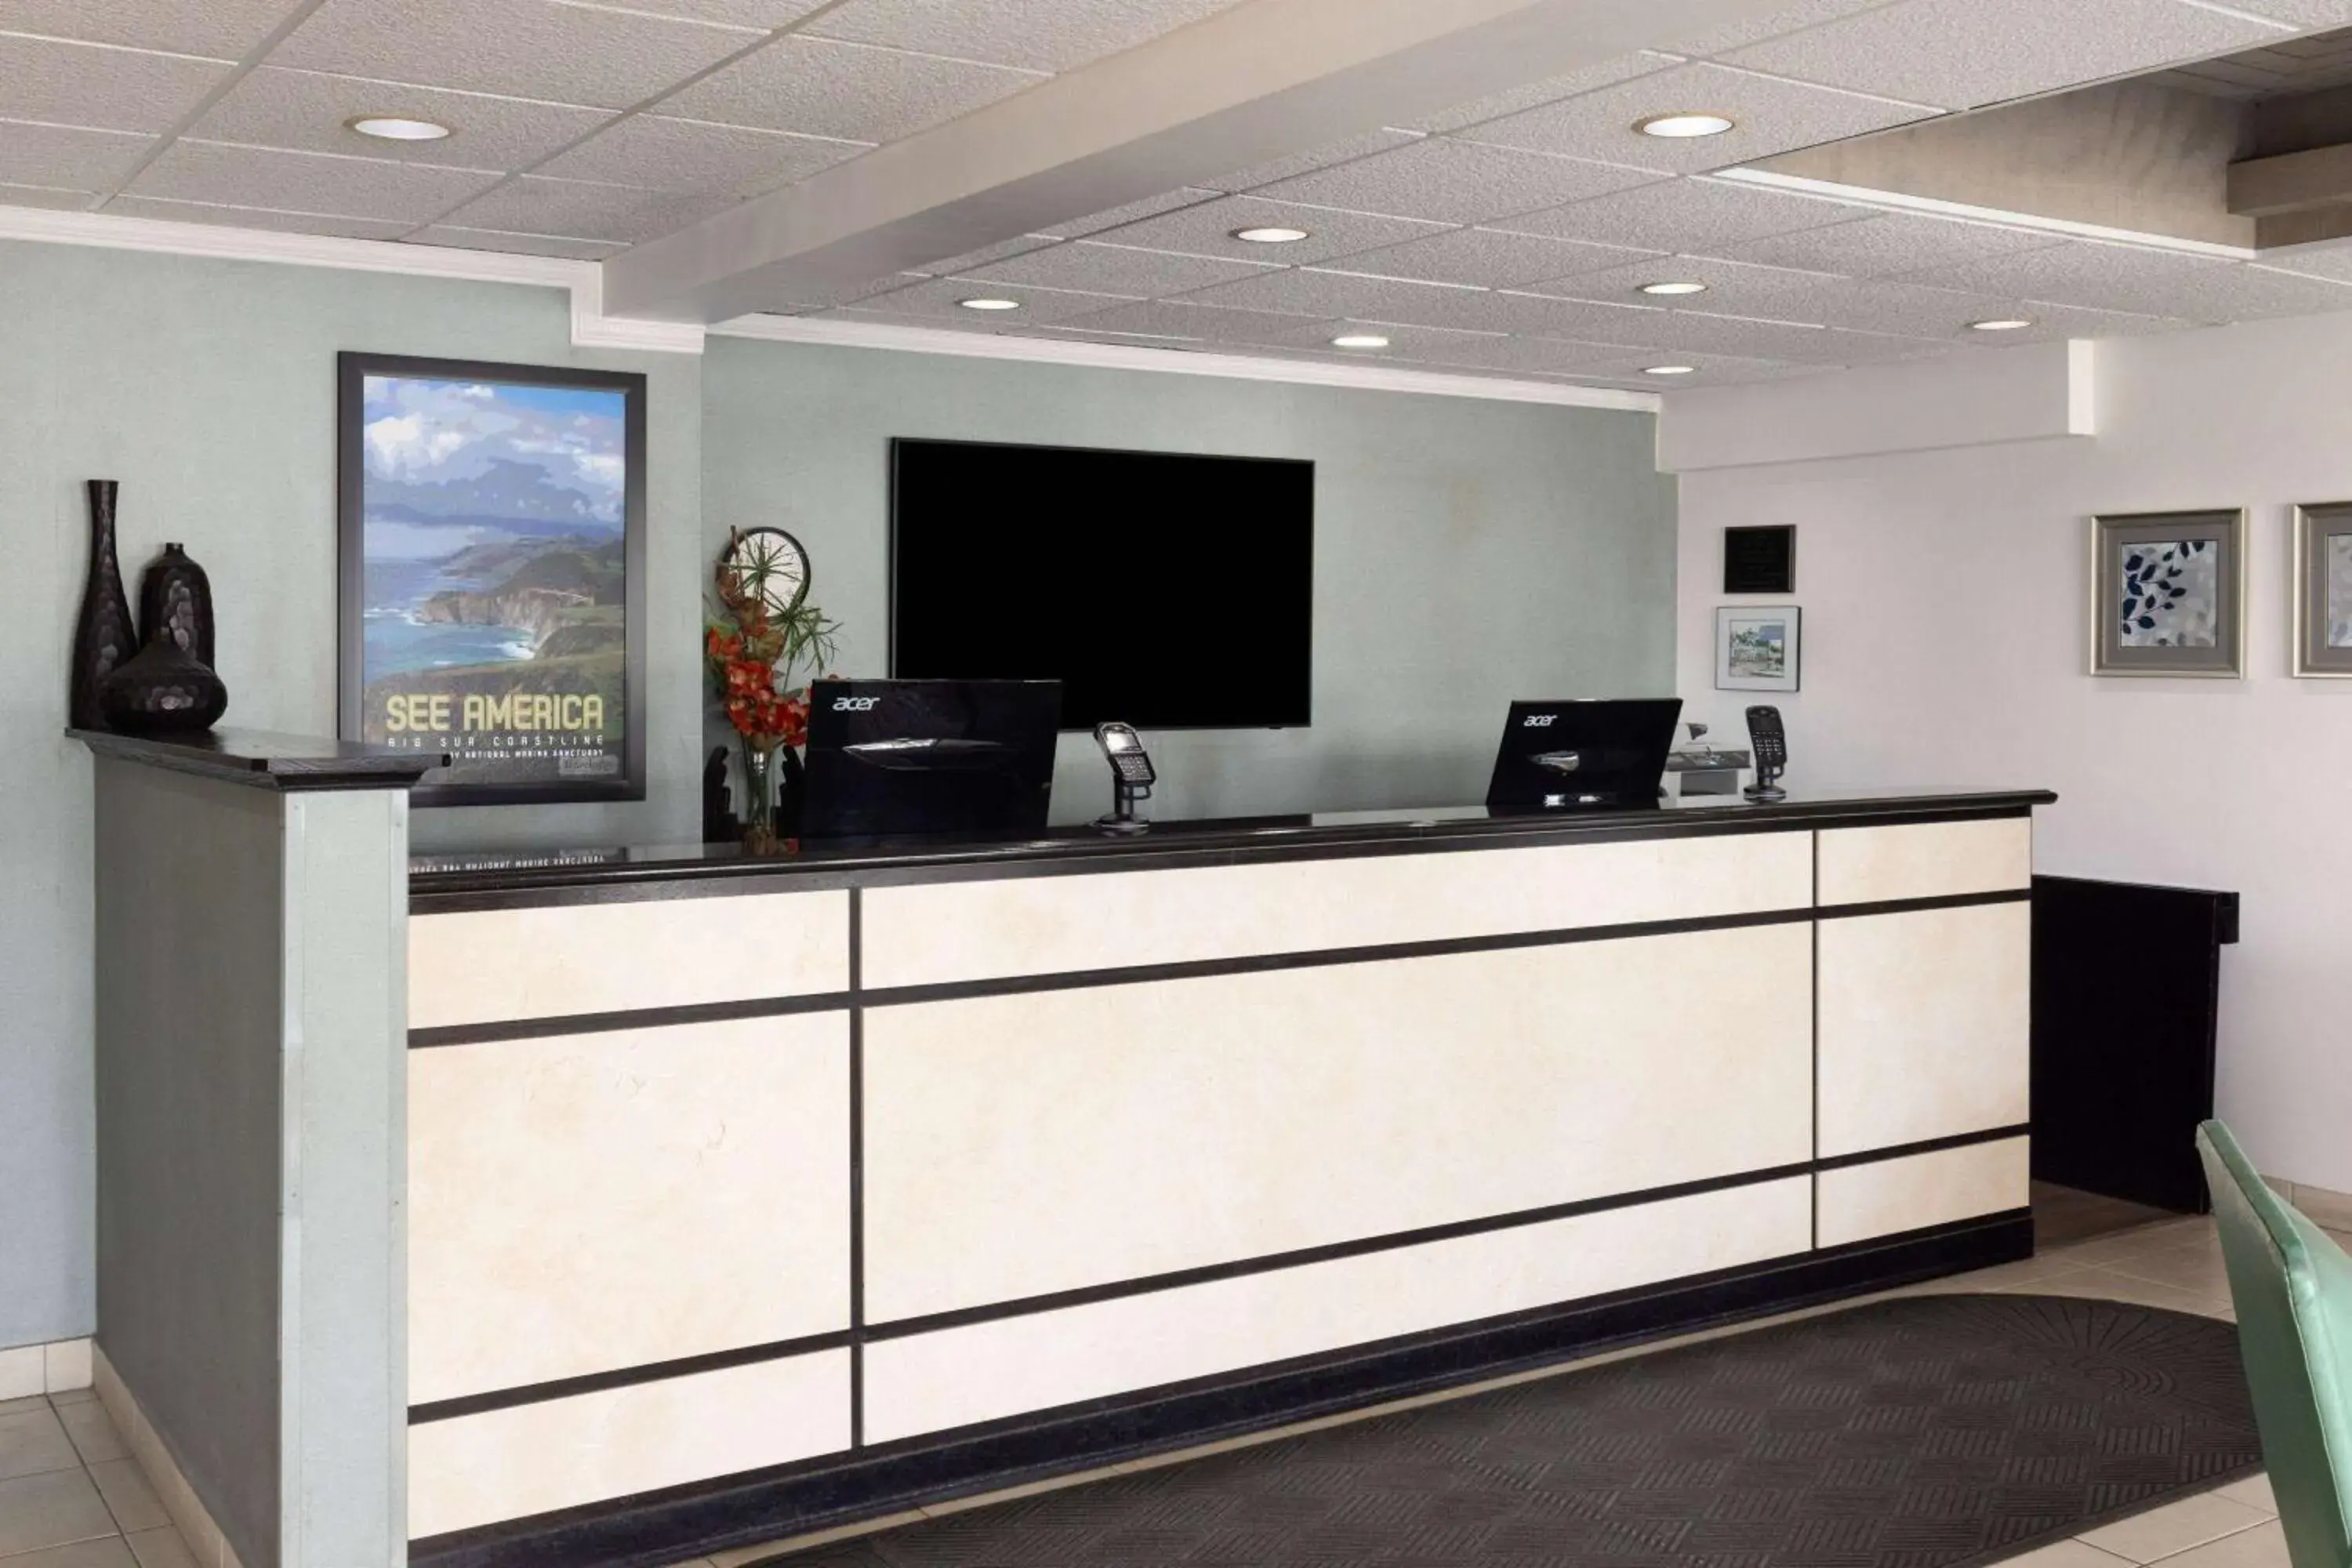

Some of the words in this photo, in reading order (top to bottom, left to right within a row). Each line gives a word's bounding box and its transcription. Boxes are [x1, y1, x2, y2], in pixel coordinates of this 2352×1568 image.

[833, 697, 880, 711] acer
[386, 694, 451, 731] SEE
[463, 694, 603, 731] AMERICA
[1523, 714, 1558, 727] acer
[388, 738, 421, 747] BIG
[439, 736, 474, 747] SUR
[493, 735, 603, 746] COASTLINE
[465, 750, 510, 759] NATIONAL
